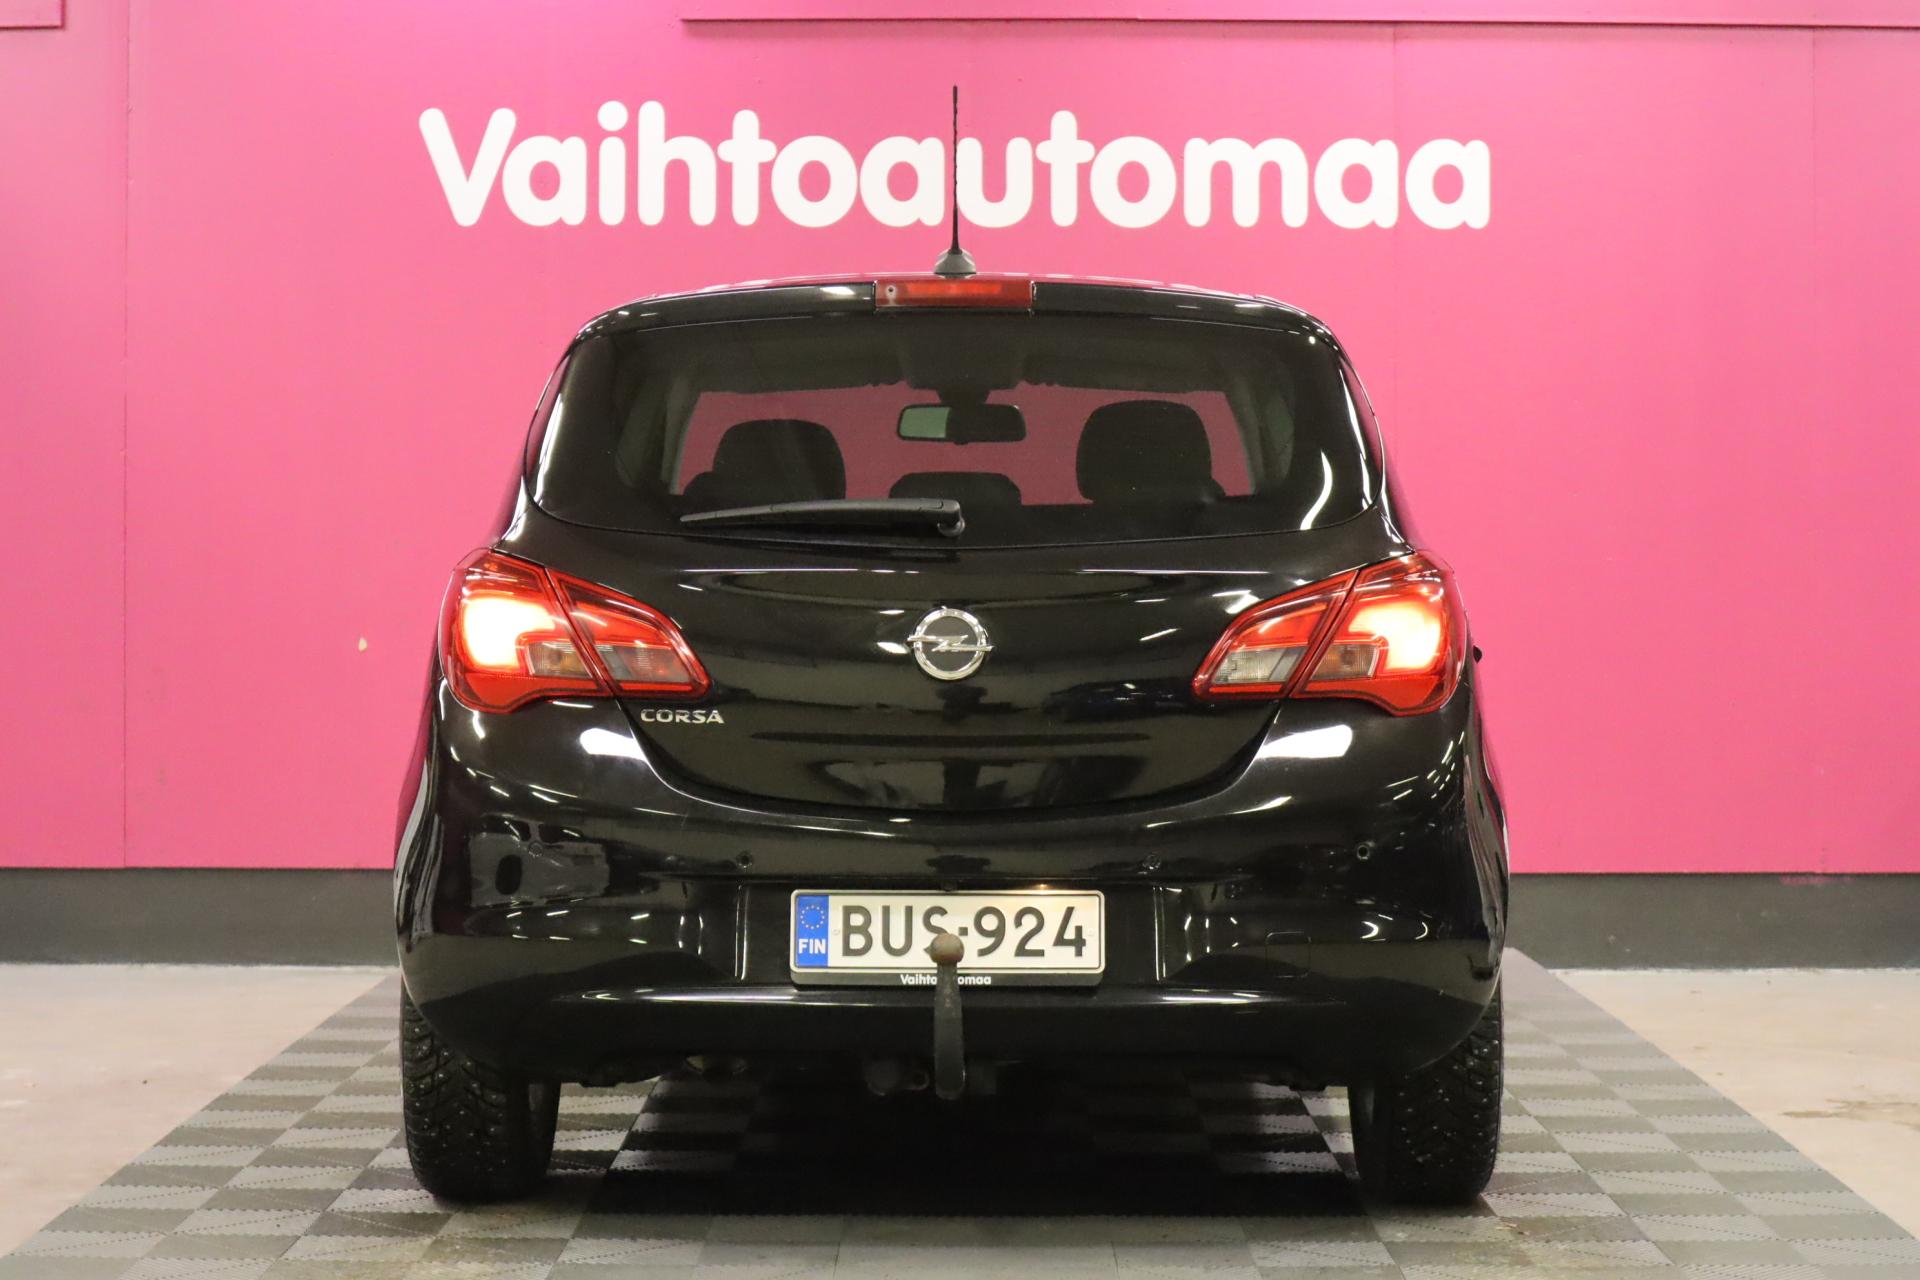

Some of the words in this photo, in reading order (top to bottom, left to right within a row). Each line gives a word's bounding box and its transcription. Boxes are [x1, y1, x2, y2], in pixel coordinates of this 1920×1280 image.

[419, 101, 1490, 229] Vaihtoautomaa
[640, 709, 725, 724] CORSA
[842, 905, 1086, 957] BUS-924
[798, 938, 827, 954] FIN
[900, 973, 992, 985] Vaihtoomaa
